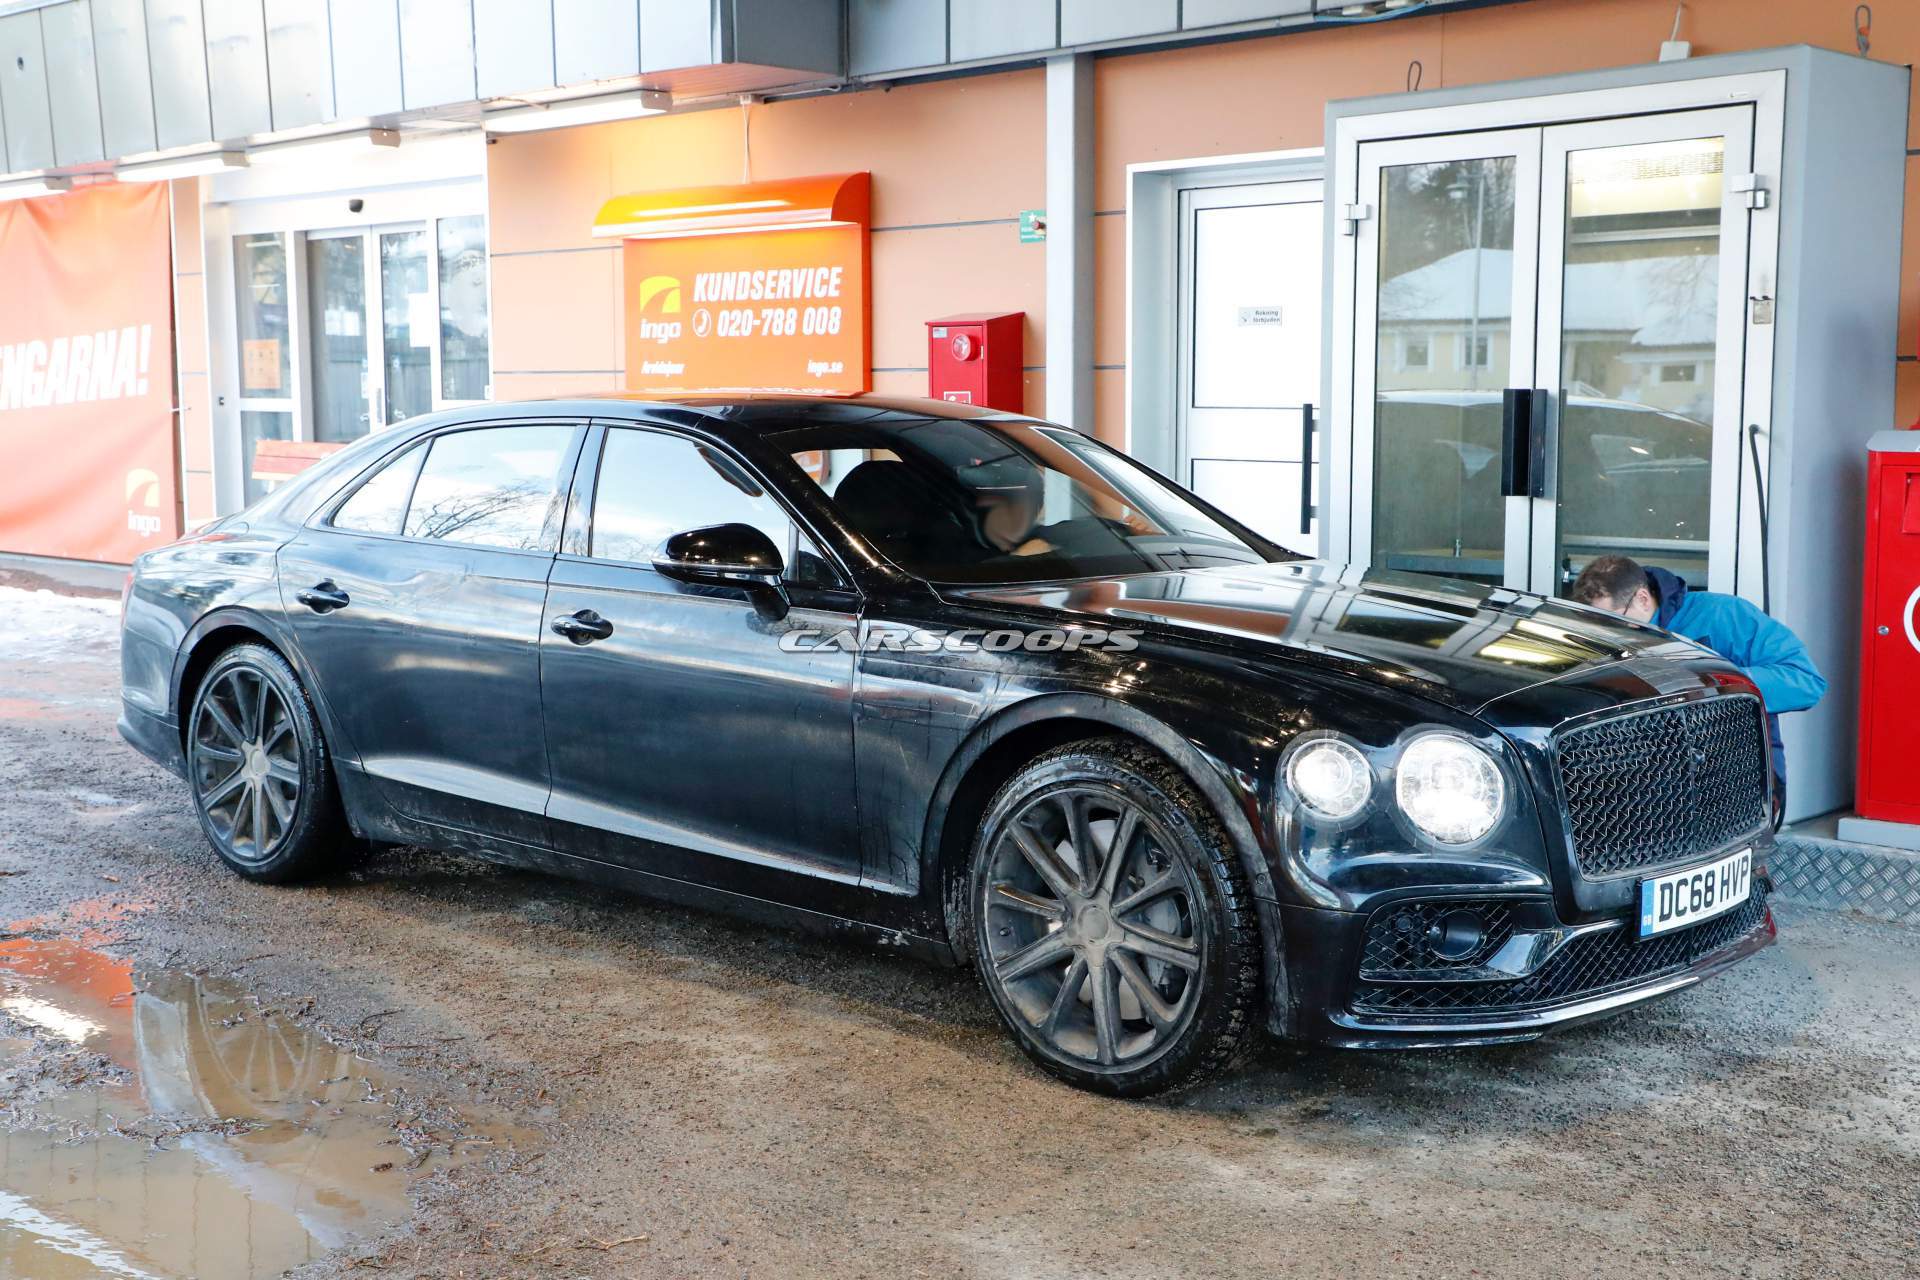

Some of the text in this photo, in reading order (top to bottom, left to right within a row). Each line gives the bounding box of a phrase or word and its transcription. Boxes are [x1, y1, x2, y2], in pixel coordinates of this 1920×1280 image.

[694, 267, 843, 302] KUNDSERVICE
[640, 318, 681, 344] ingo
[717, 306, 841, 337] 020-788 008
[0, 324, 152, 410] NGARNA!
[807, 359, 844, 377] ingo.se
[127, 509, 160, 537] ingo
[1659, 855, 1749, 922] DC68 HVP
